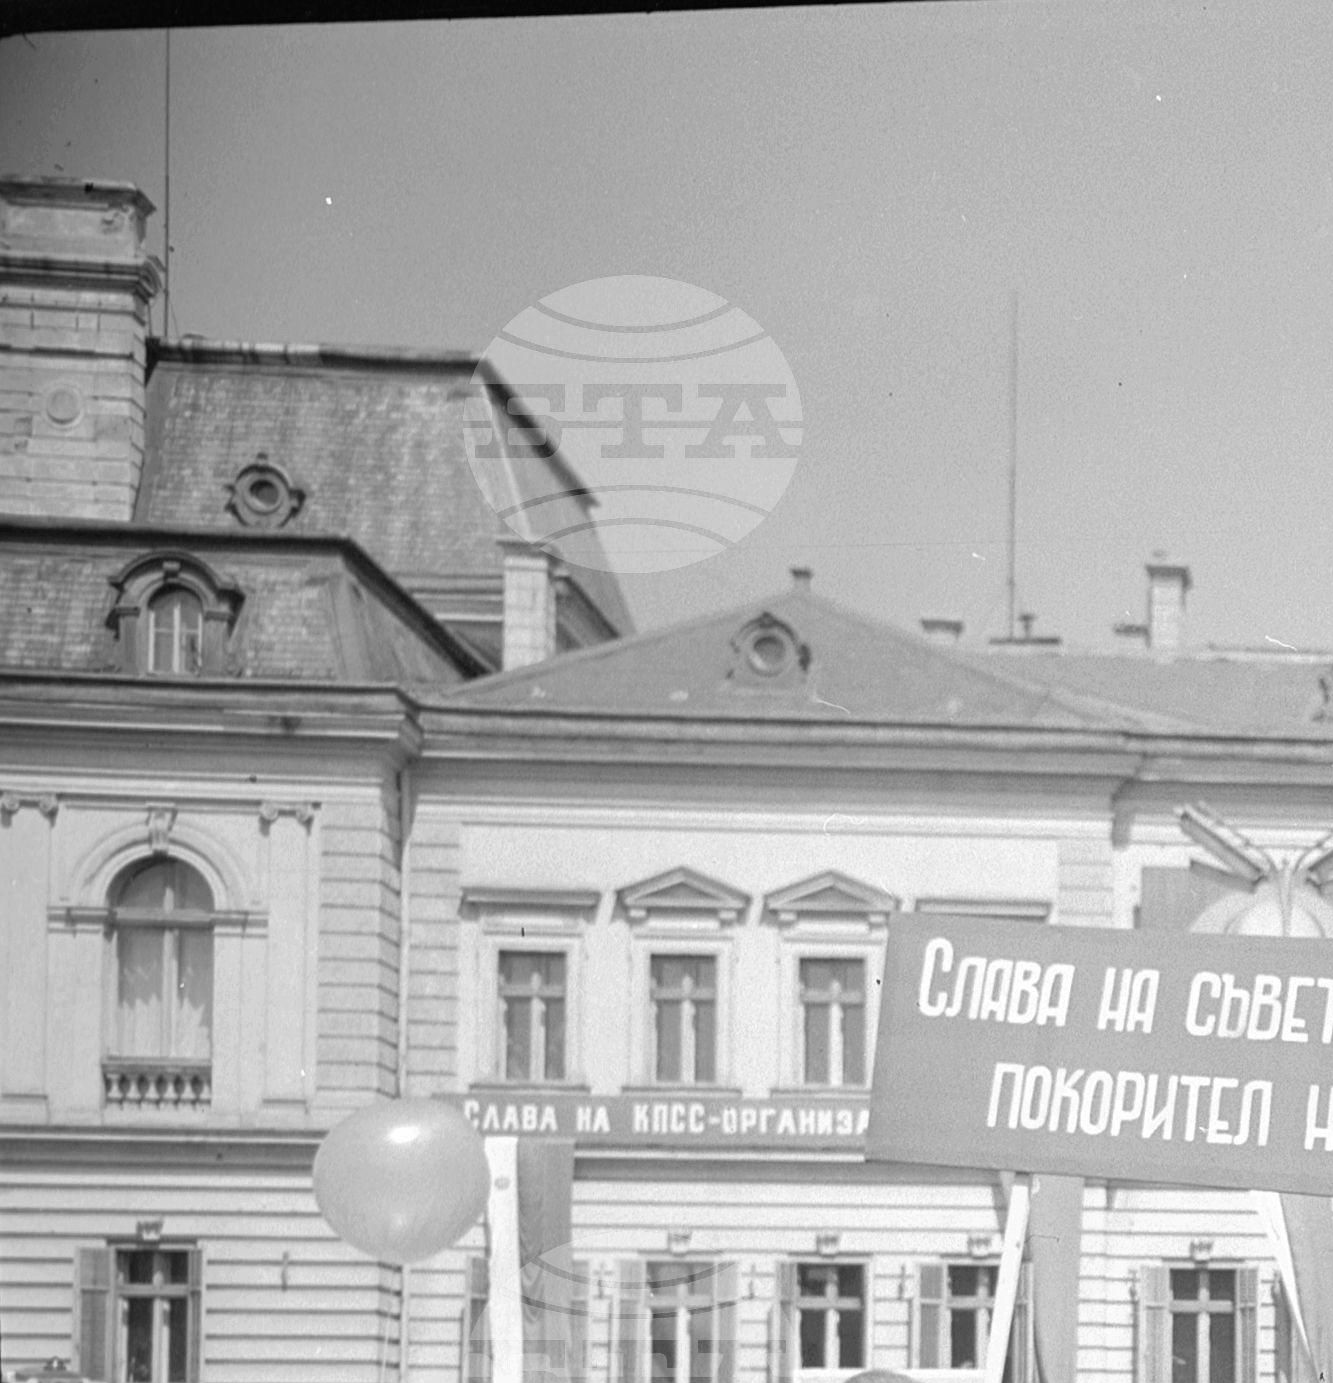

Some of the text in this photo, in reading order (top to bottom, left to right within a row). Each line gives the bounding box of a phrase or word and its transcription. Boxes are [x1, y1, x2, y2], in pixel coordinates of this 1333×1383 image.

[463, 1099, 558, 1132] СЛАВА
[576, 1103, 611, 1133] НА
[987, 1062, 1273, 1147] ПОКОРИТЕЛ
